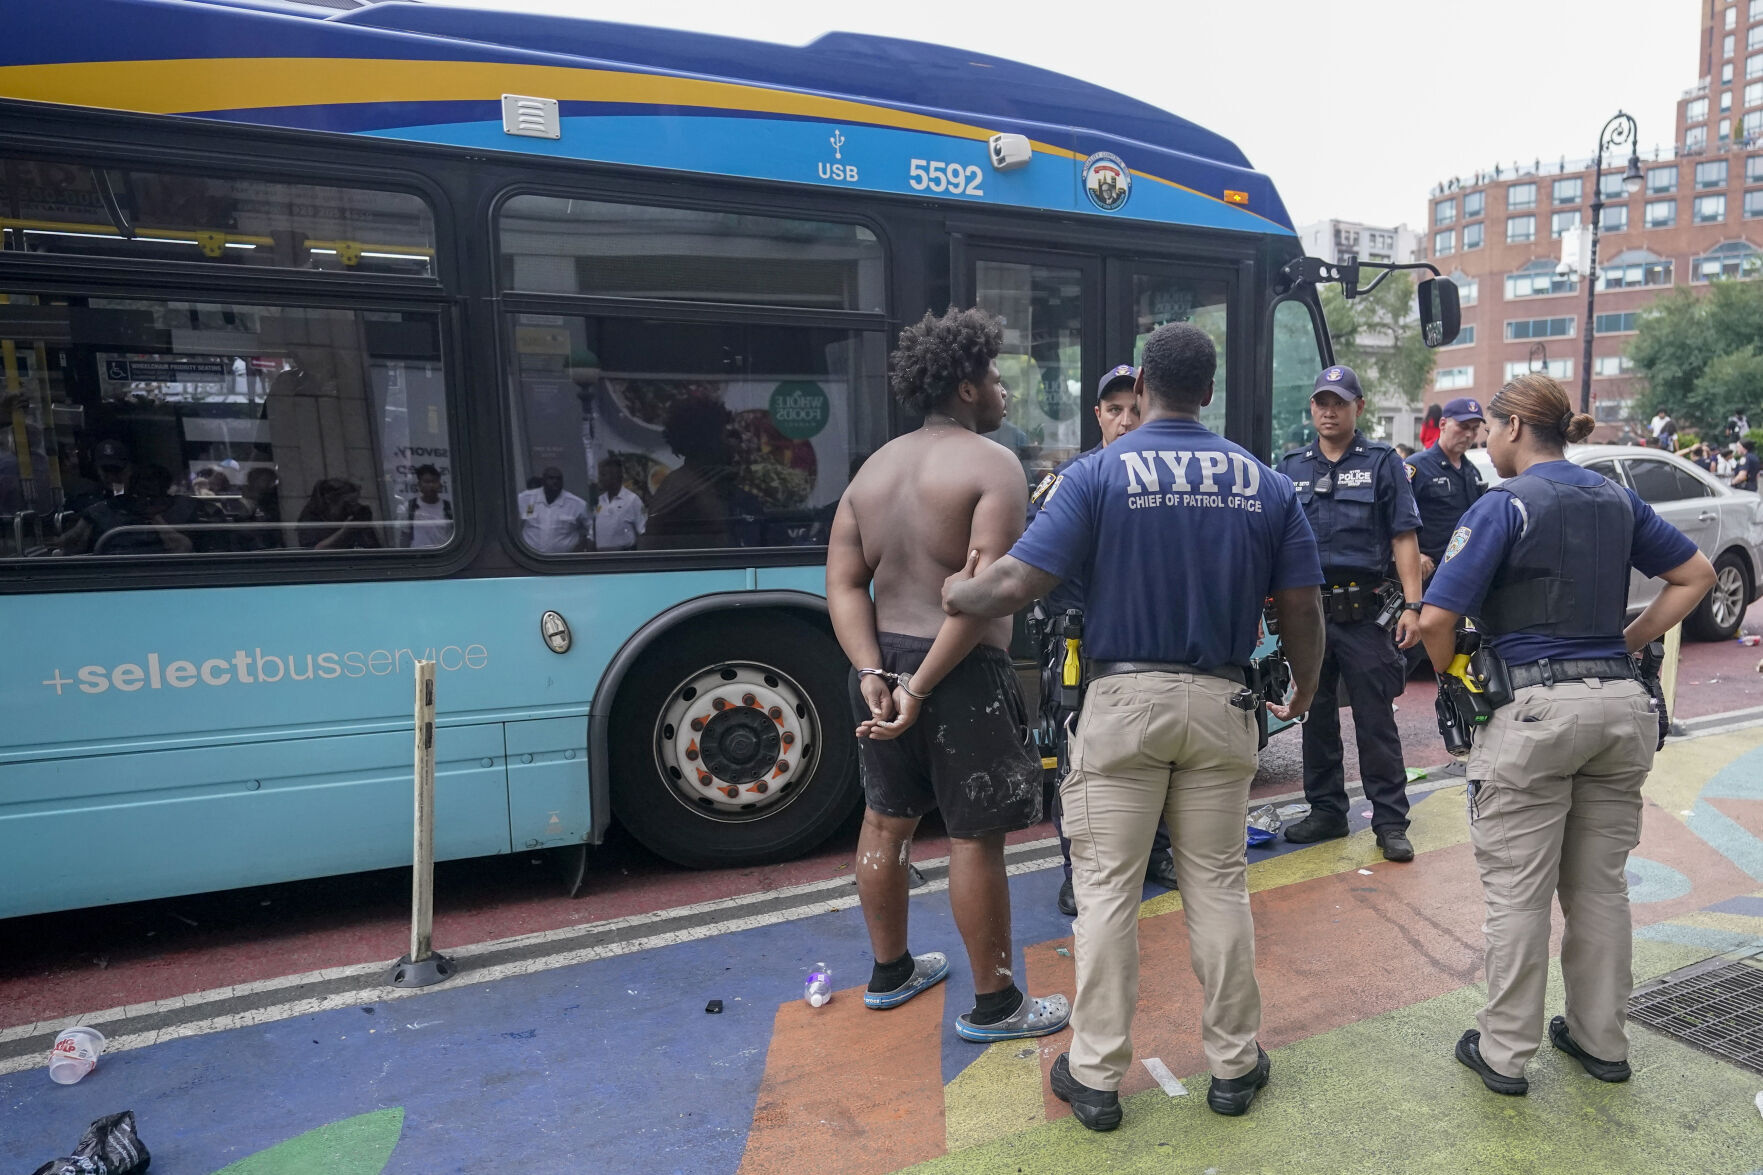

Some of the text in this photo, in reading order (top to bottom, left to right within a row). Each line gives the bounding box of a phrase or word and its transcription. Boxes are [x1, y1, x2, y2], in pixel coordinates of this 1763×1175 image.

[818, 162, 859, 182] USB
[909, 158, 984, 196] 5592
[1119, 450, 1260, 497] NYPD
[1338, 472, 1371, 481] POLICE
[1128, 494, 1162, 509] CHIEF
[1165, 493, 1180, 506] OF
[1183, 494, 1224, 507] PATROL
